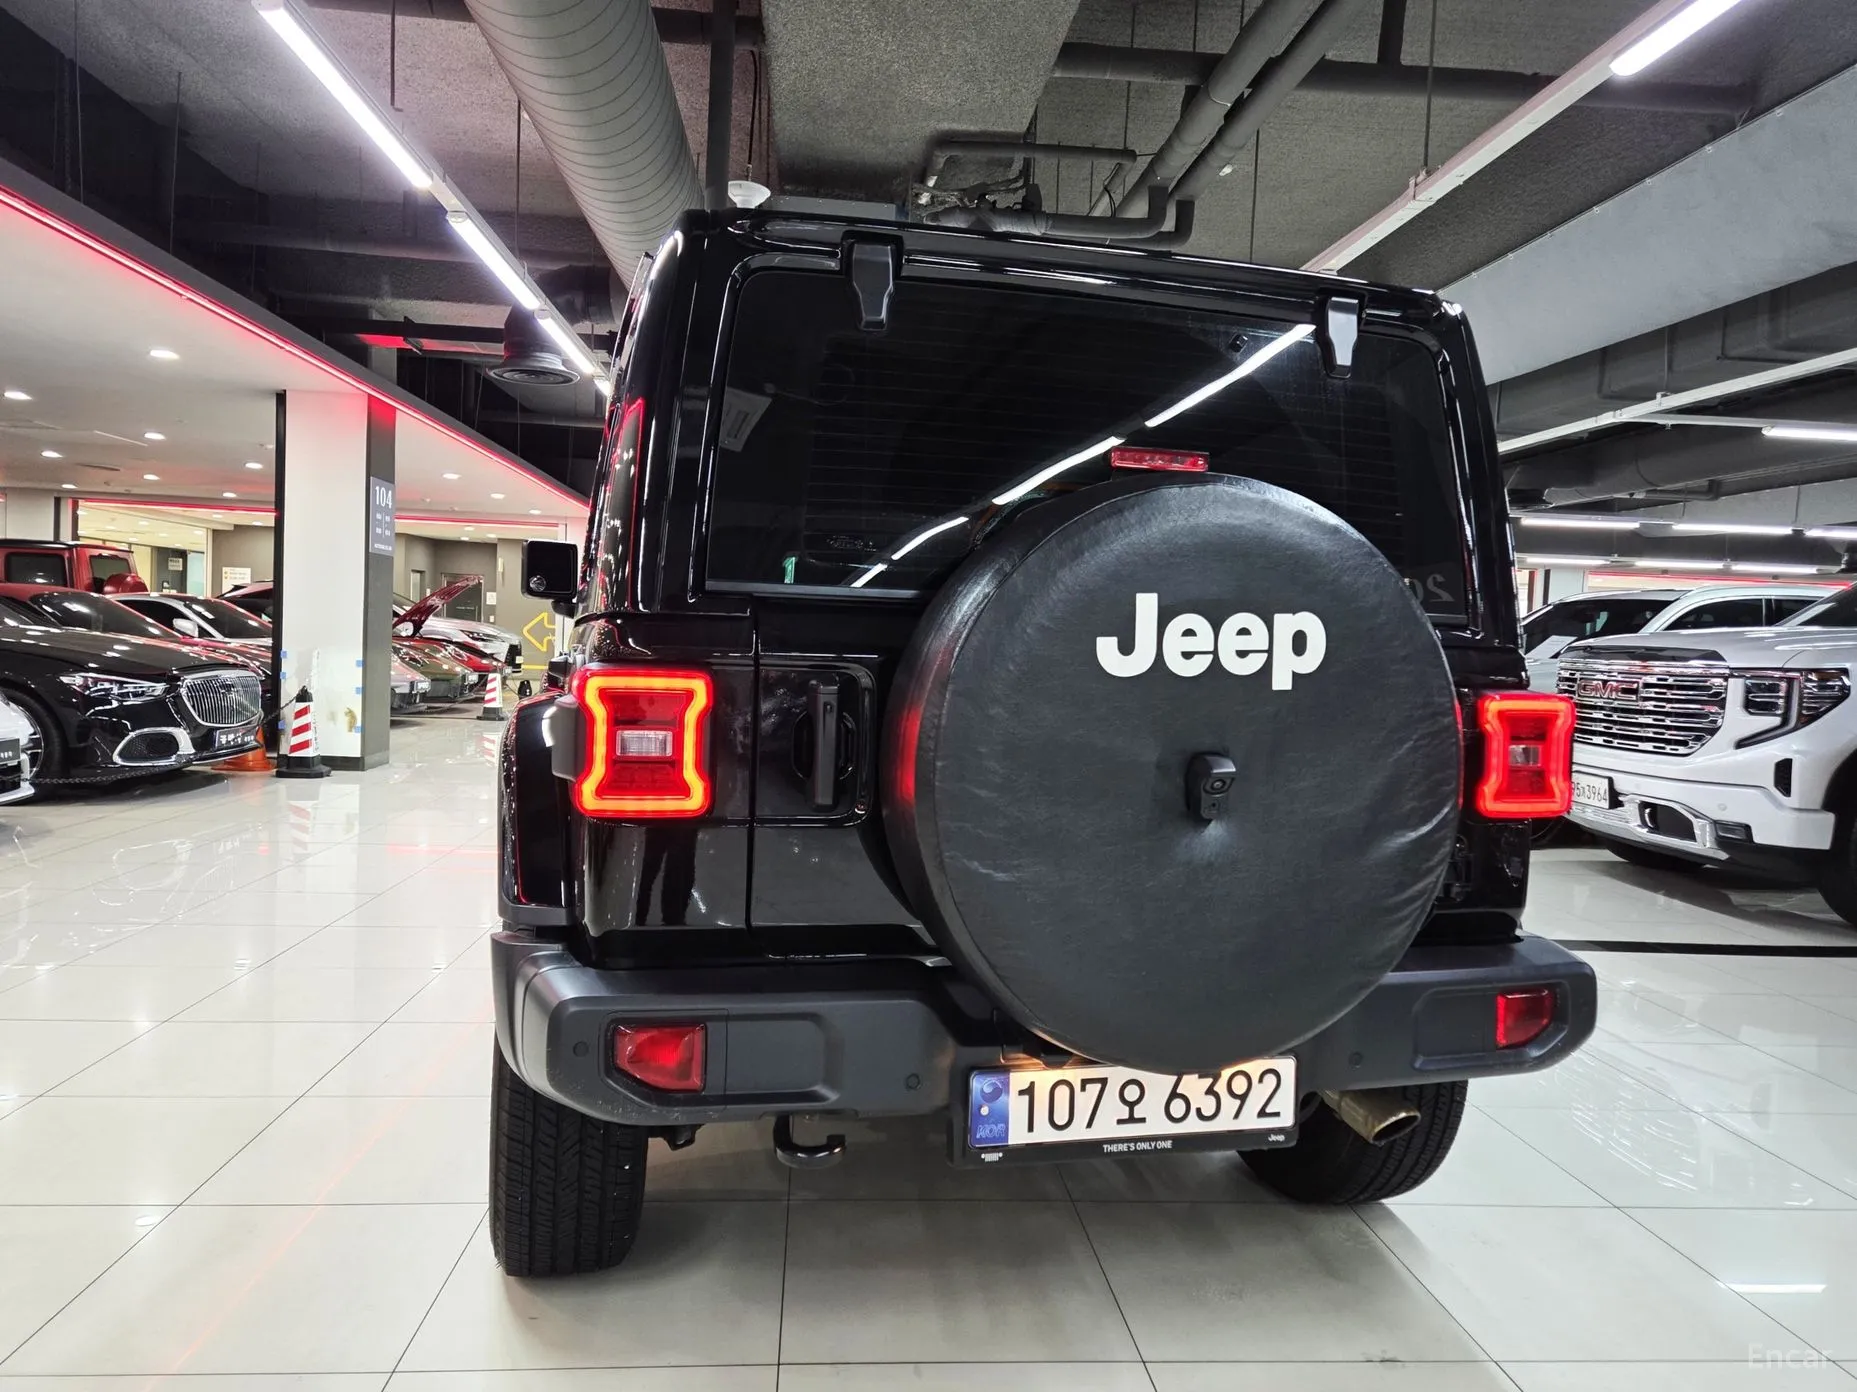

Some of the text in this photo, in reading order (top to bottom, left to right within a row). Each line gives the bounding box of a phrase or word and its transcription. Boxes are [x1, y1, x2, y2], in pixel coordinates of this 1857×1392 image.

[375, 486, 392, 509] 104
[1096, 592, 1327, 690] Jeep
[1578, 680, 1638, 700] GMC
[1018, 1068, 1282, 1133] 107오 6392
[976, 1123, 1007, 1139] KOR
[1267, 1133, 1285, 1142] Jeep
[1102, 1139, 1173, 1153] THERE'S ONLY ONE
